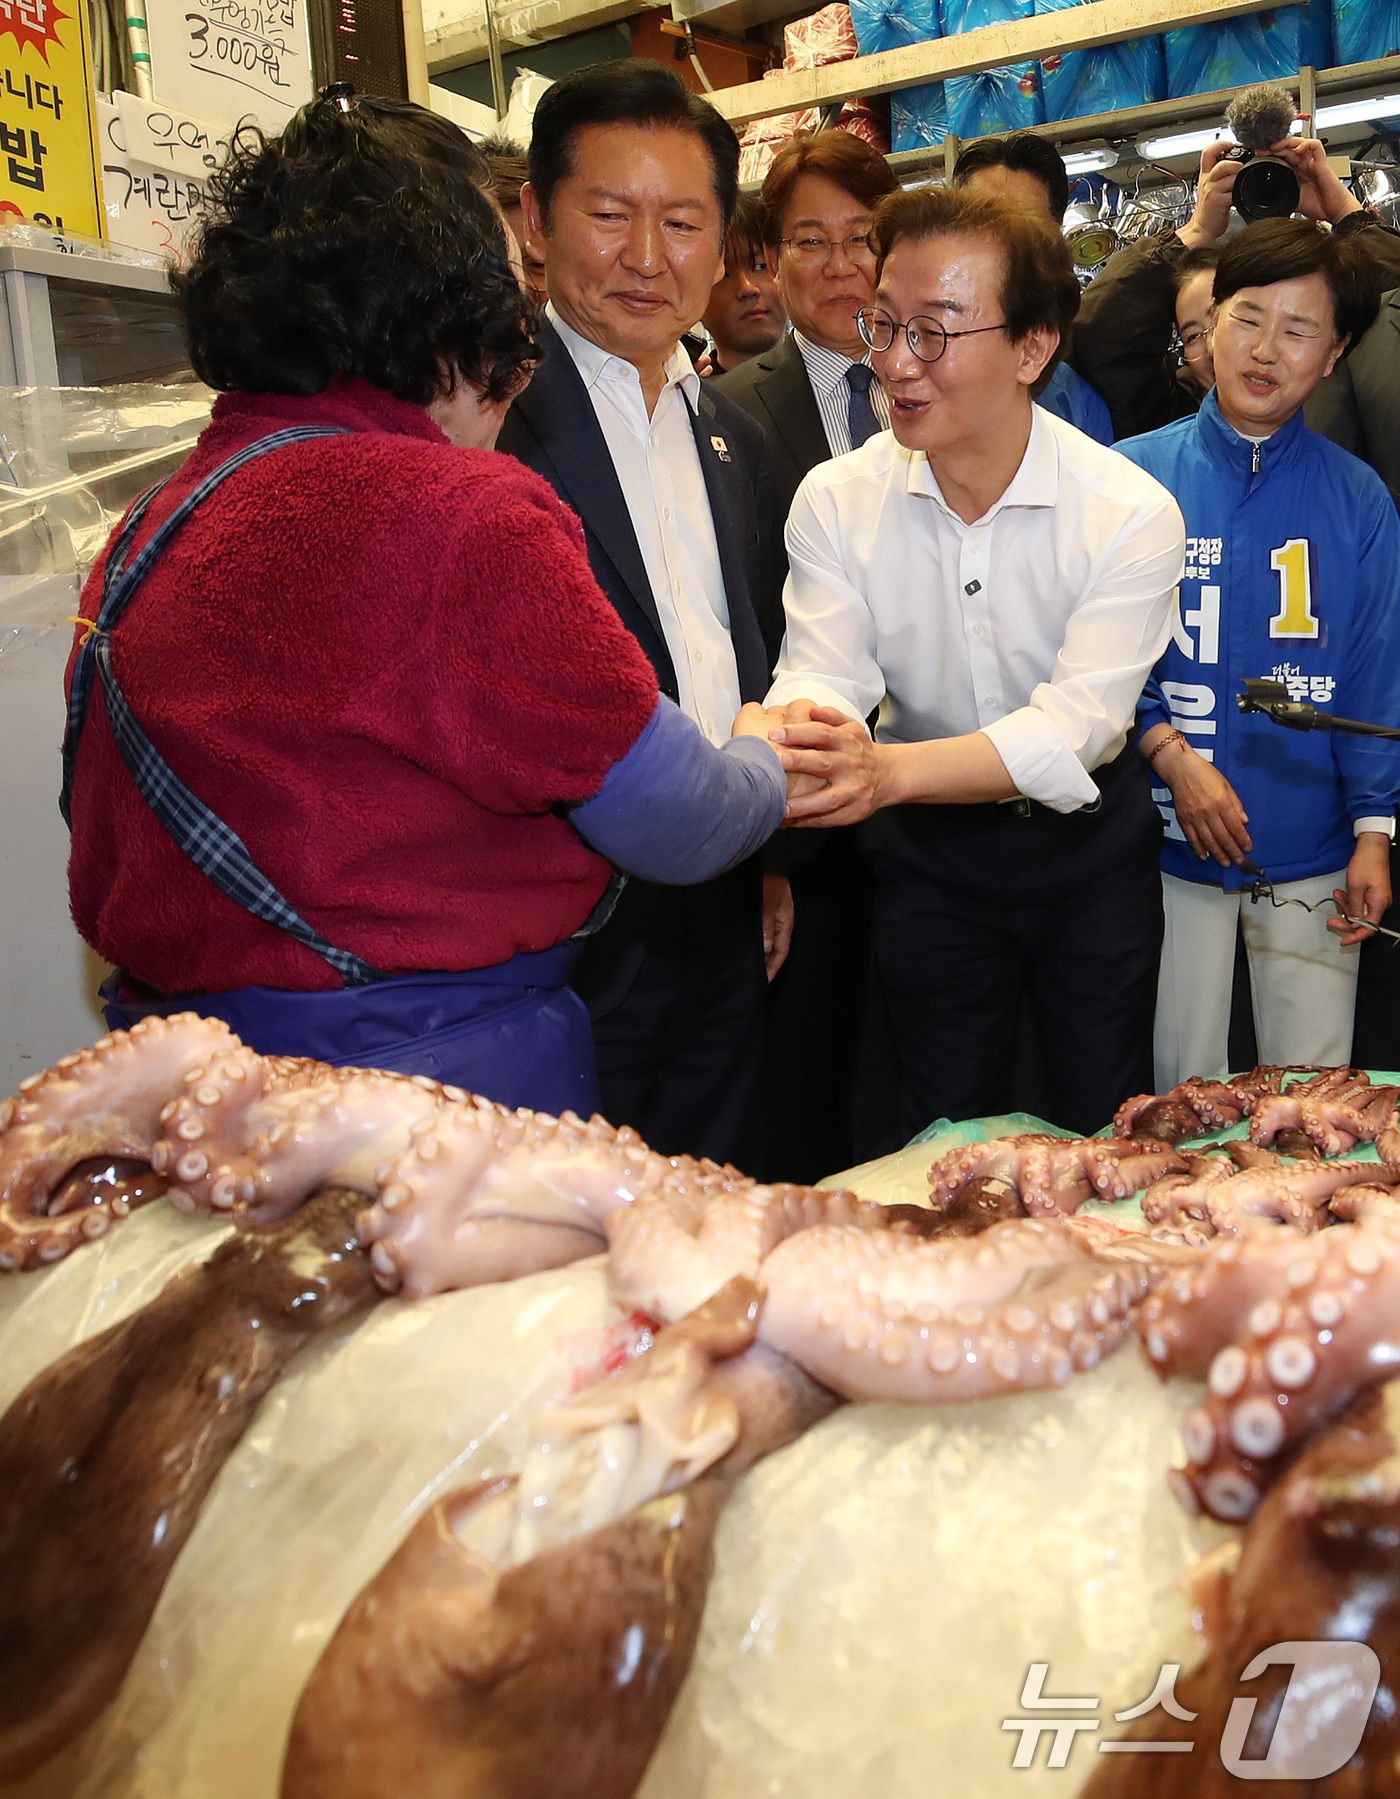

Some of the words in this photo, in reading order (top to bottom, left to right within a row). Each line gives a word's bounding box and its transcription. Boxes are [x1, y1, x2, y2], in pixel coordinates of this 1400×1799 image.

[0, 68, 63, 121] 니다
[1185, 537, 1223, 566] 구청장
[1269, 538, 1319, 639] 1
[1271, 662, 1301, 677] 더불어
[1260, 675, 1336, 702] 주당
